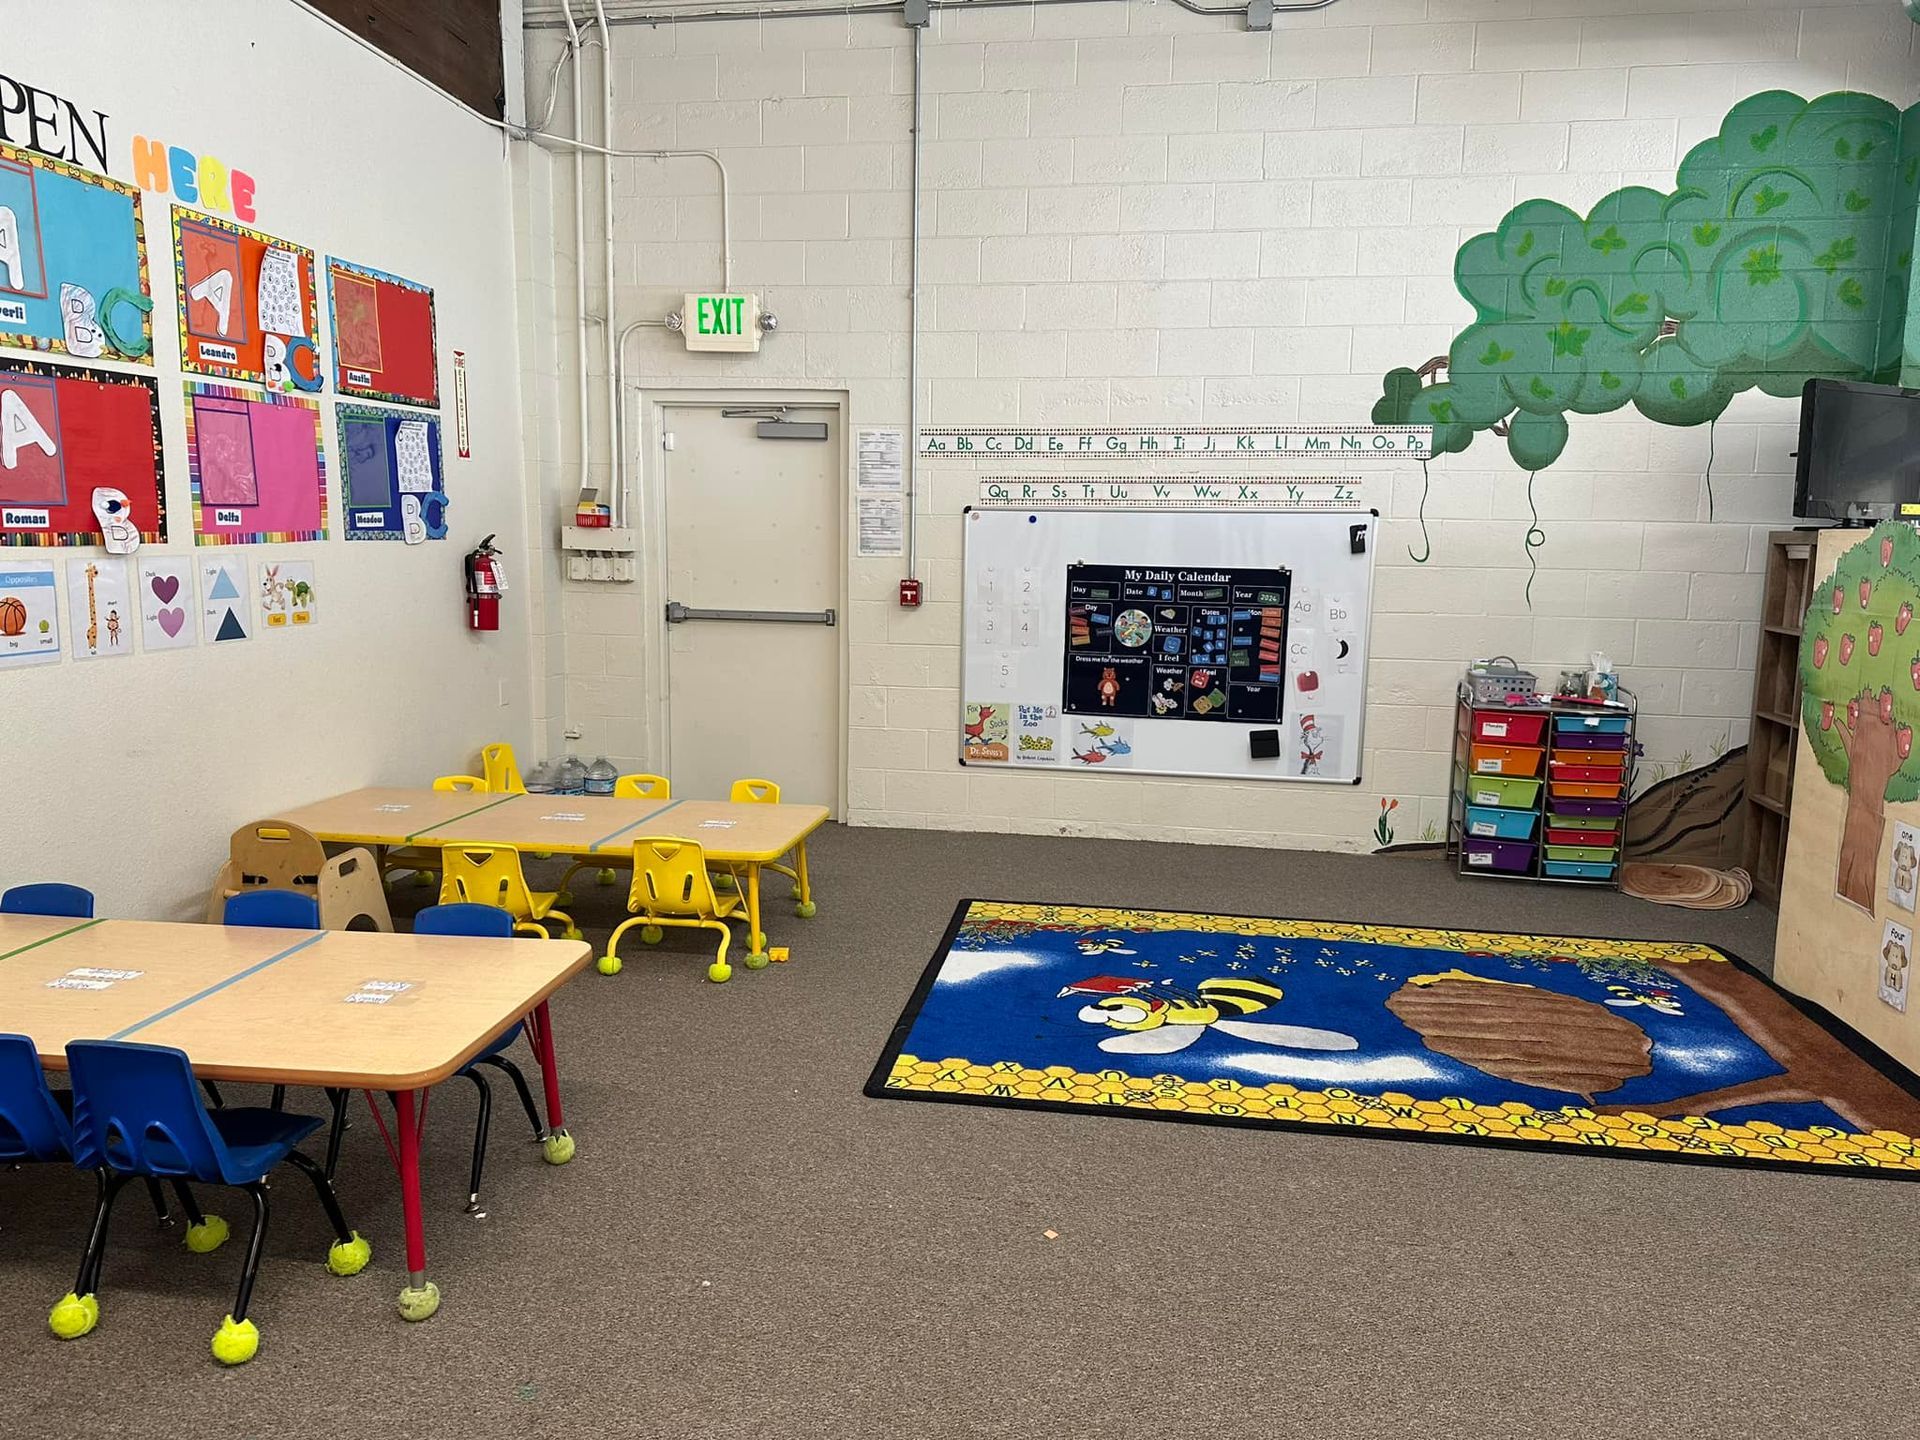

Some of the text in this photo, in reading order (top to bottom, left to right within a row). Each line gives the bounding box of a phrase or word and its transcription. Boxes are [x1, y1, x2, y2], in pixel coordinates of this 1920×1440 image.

[132, 135, 256, 223] HERE
[697, 298, 745, 335] EXIT
[200, 345, 236, 361] Leandro
[349, 371, 370, 384] Austin
[0, 389, 57, 469] A
[928, 437, 946, 450] Aa
[957, 437, 973, 450] Bb
[986, 437, 1002, 450] Cc
[1015, 437, 1033, 450] Dd
[1048, 437, 1064, 451] Ee
[1079, 437, 1092, 450] Ff
[1106, 437, 1127, 452] Gg
[1140, 437, 1158, 450] Hh
[1204, 436, 1216, 452] Jj
[1237, 436, 1255, 449] Kk
[1305, 436, 1330, 449] Mm
[1341, 436, 1361, 449] Nn
[1372, 436, 1394, 449] Oo
[1408, 436, 1423, 452] Pp
[988, 485, 1353, 504] Qq Rr Ss Tt Uu Vv Ww Xx Yy Zz
[5, 512, 47, 526] Roman
[356, 514, 382, 525] Meadow
[1125, 570, 1232, 583] My Daily Calendar
[1023, 581, 1031, 593] 2
[1294, 601, 1311, 613] Aa
[1329, 609, 1347, 620] Bb
[986, 620, 994, 631] 3
[1021, 623, 1029, 633] 4
[1154, 626, 1187, 634] Weather
[1291, 643, 1308, 655] Cc
[1001, 665, 1009, 676] 5
[1156, 667, 1183, 675] Weather
[967, 704, 978, 715] Fox
[1018, 704, 1031, 713] Put
[1030, 713, 1043, 721] the
[1901, 829, 1913, 841] one
[1890, 972, 1897, 986] 4
